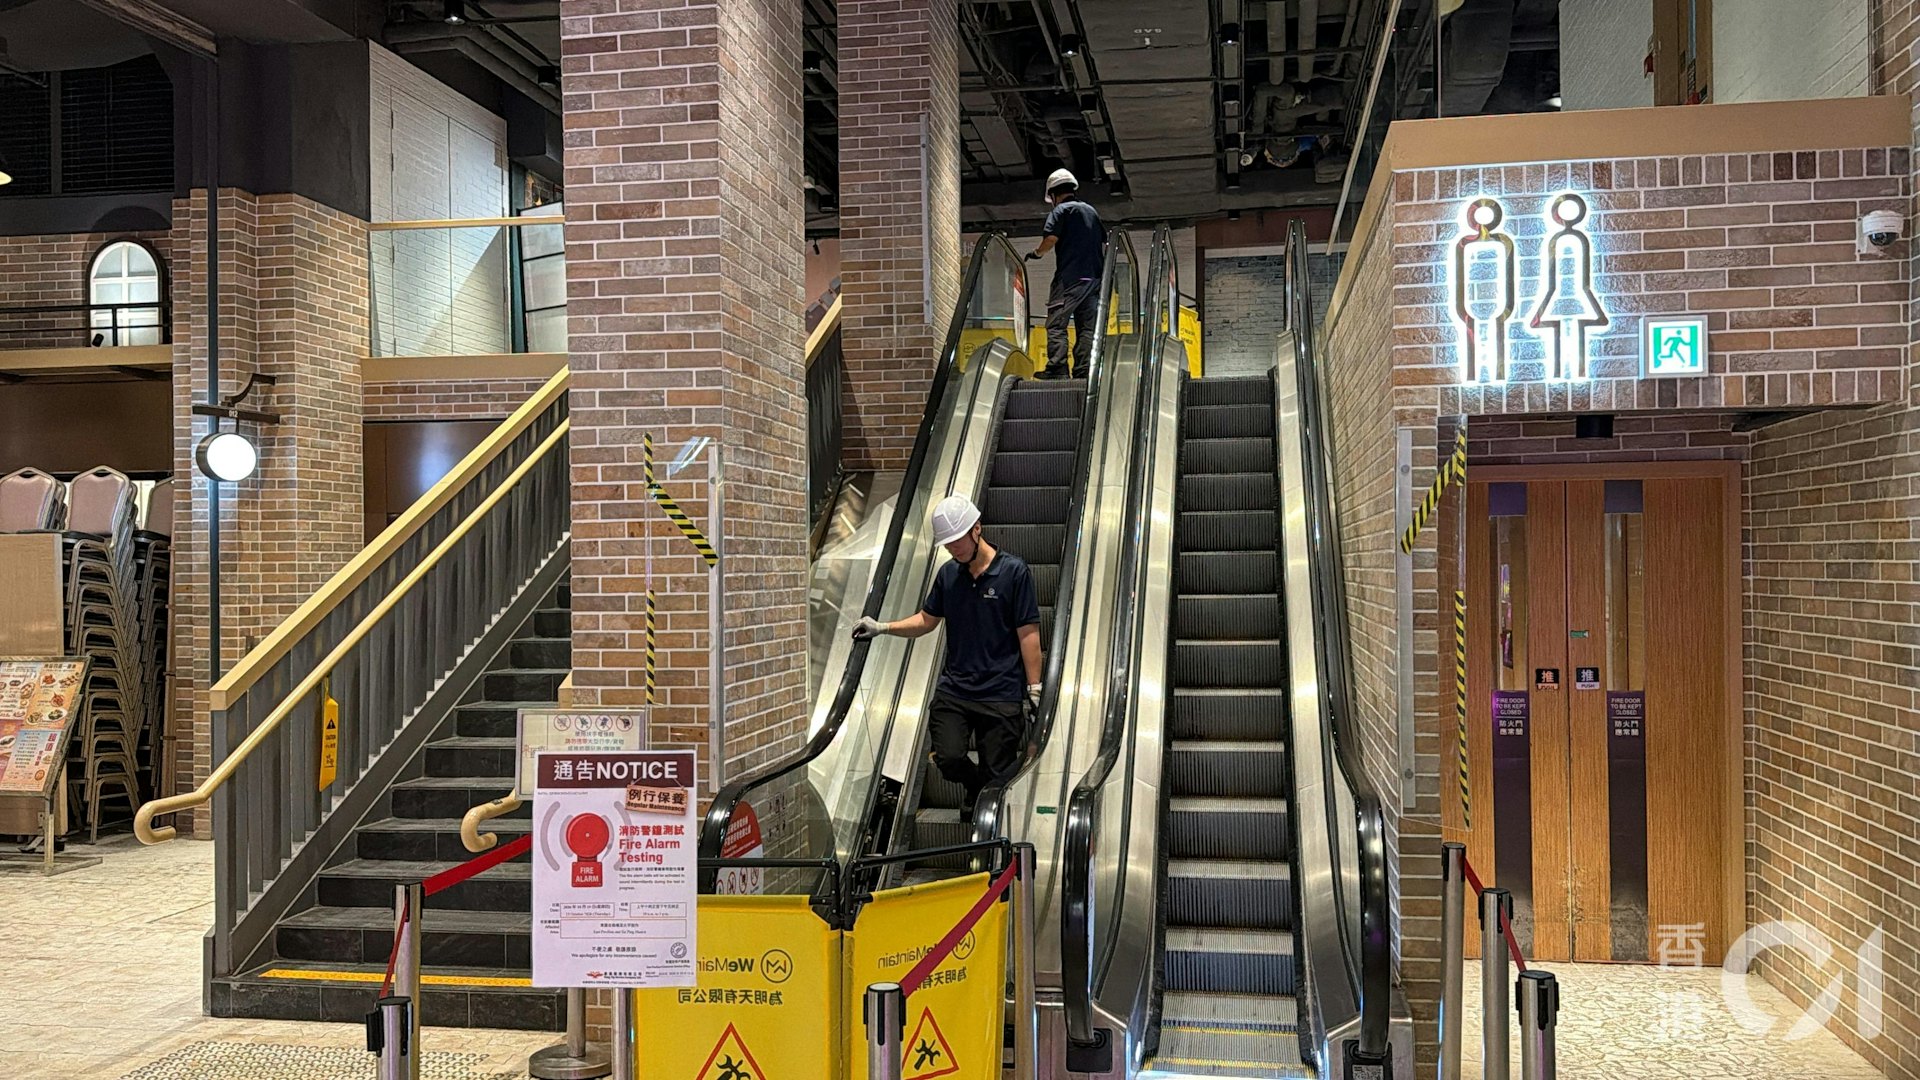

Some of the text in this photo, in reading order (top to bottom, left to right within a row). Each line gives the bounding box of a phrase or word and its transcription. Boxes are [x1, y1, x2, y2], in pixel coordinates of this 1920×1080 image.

[1541, 670, 1554, 683] 推
[1581, 669, 1594, 682] 推
[628, 788, 685, 805] 例行保養
[619, 825, 684, 836] 消防警鐘測試
[619, 839, 680, 849] Fire Alarm
[619, 852, 663, 865] Testing
